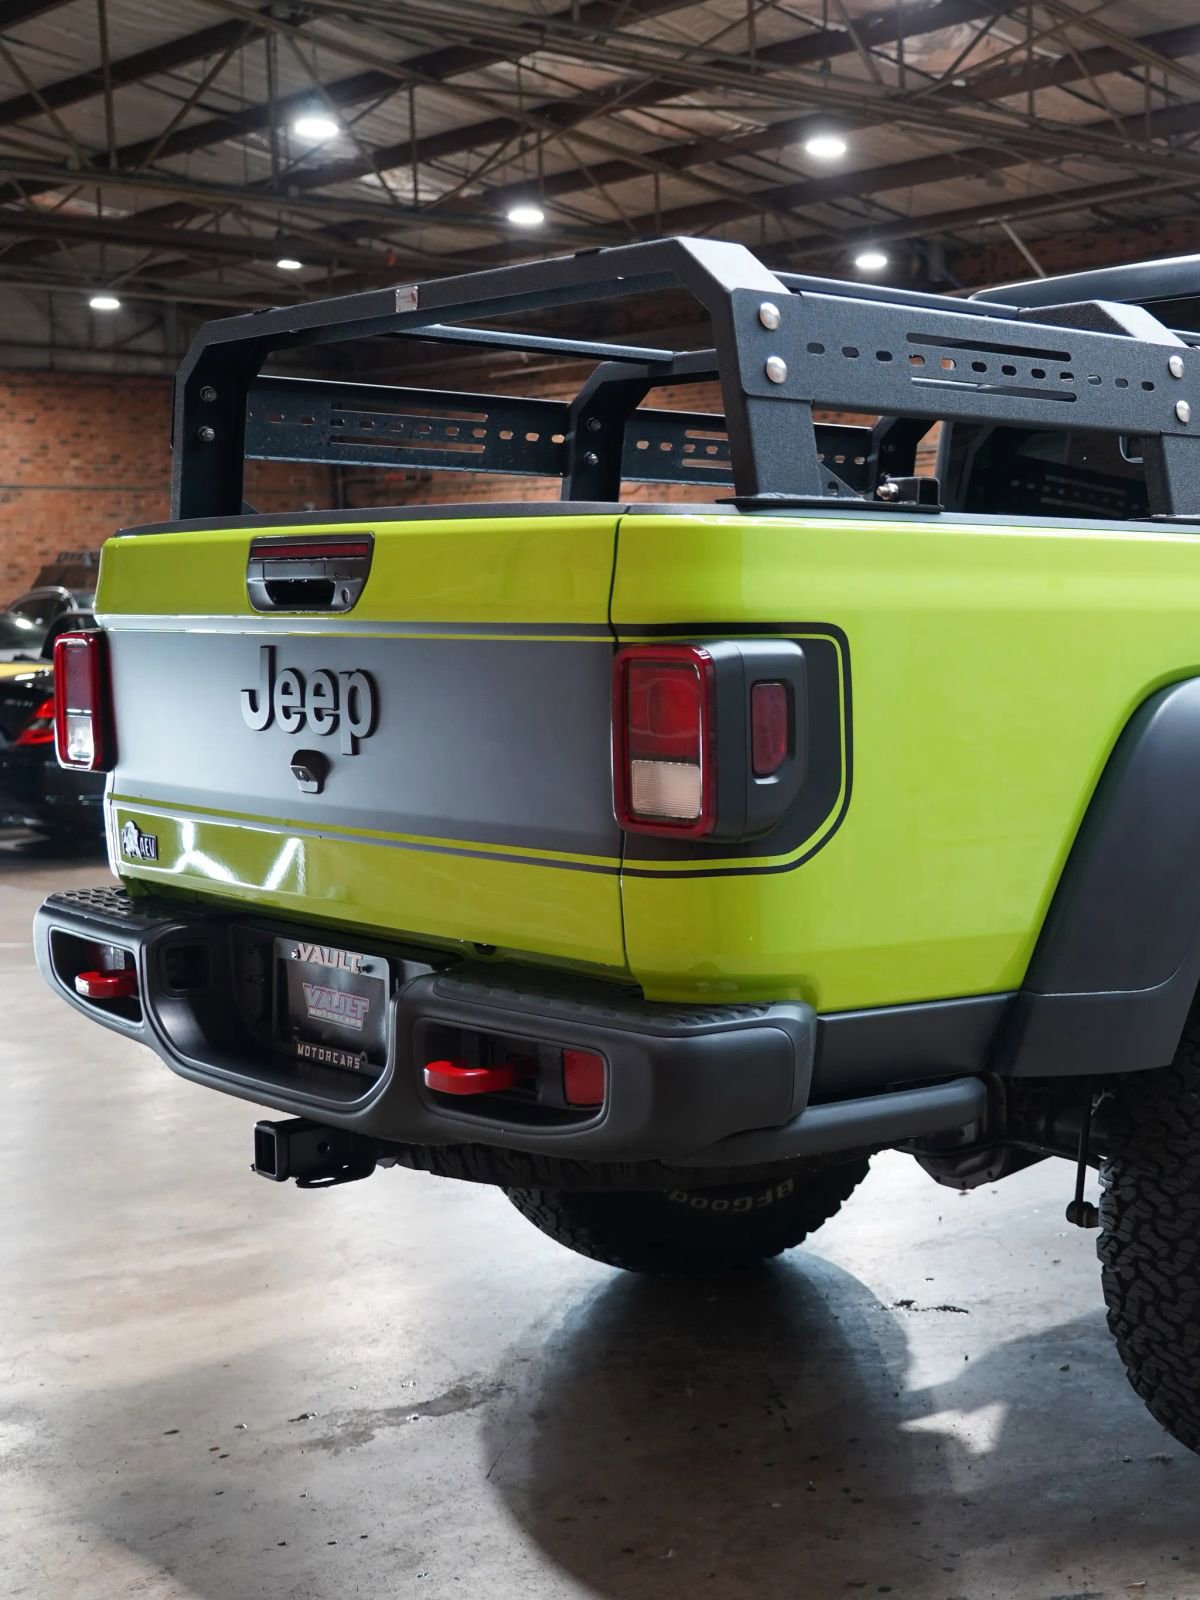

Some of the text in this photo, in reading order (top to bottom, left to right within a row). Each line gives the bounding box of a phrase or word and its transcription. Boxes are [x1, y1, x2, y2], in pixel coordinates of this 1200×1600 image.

[240, 645, 378, 756] Jeep
[140, 836, 156, 859] AEV
[298, 943, 363, 974] VAULT
[303, 983, 369, 1020] VAULT
[297, 1043, 361, 1069] MOTORCARS
[663, 1178, 794, 1212] BFGood
